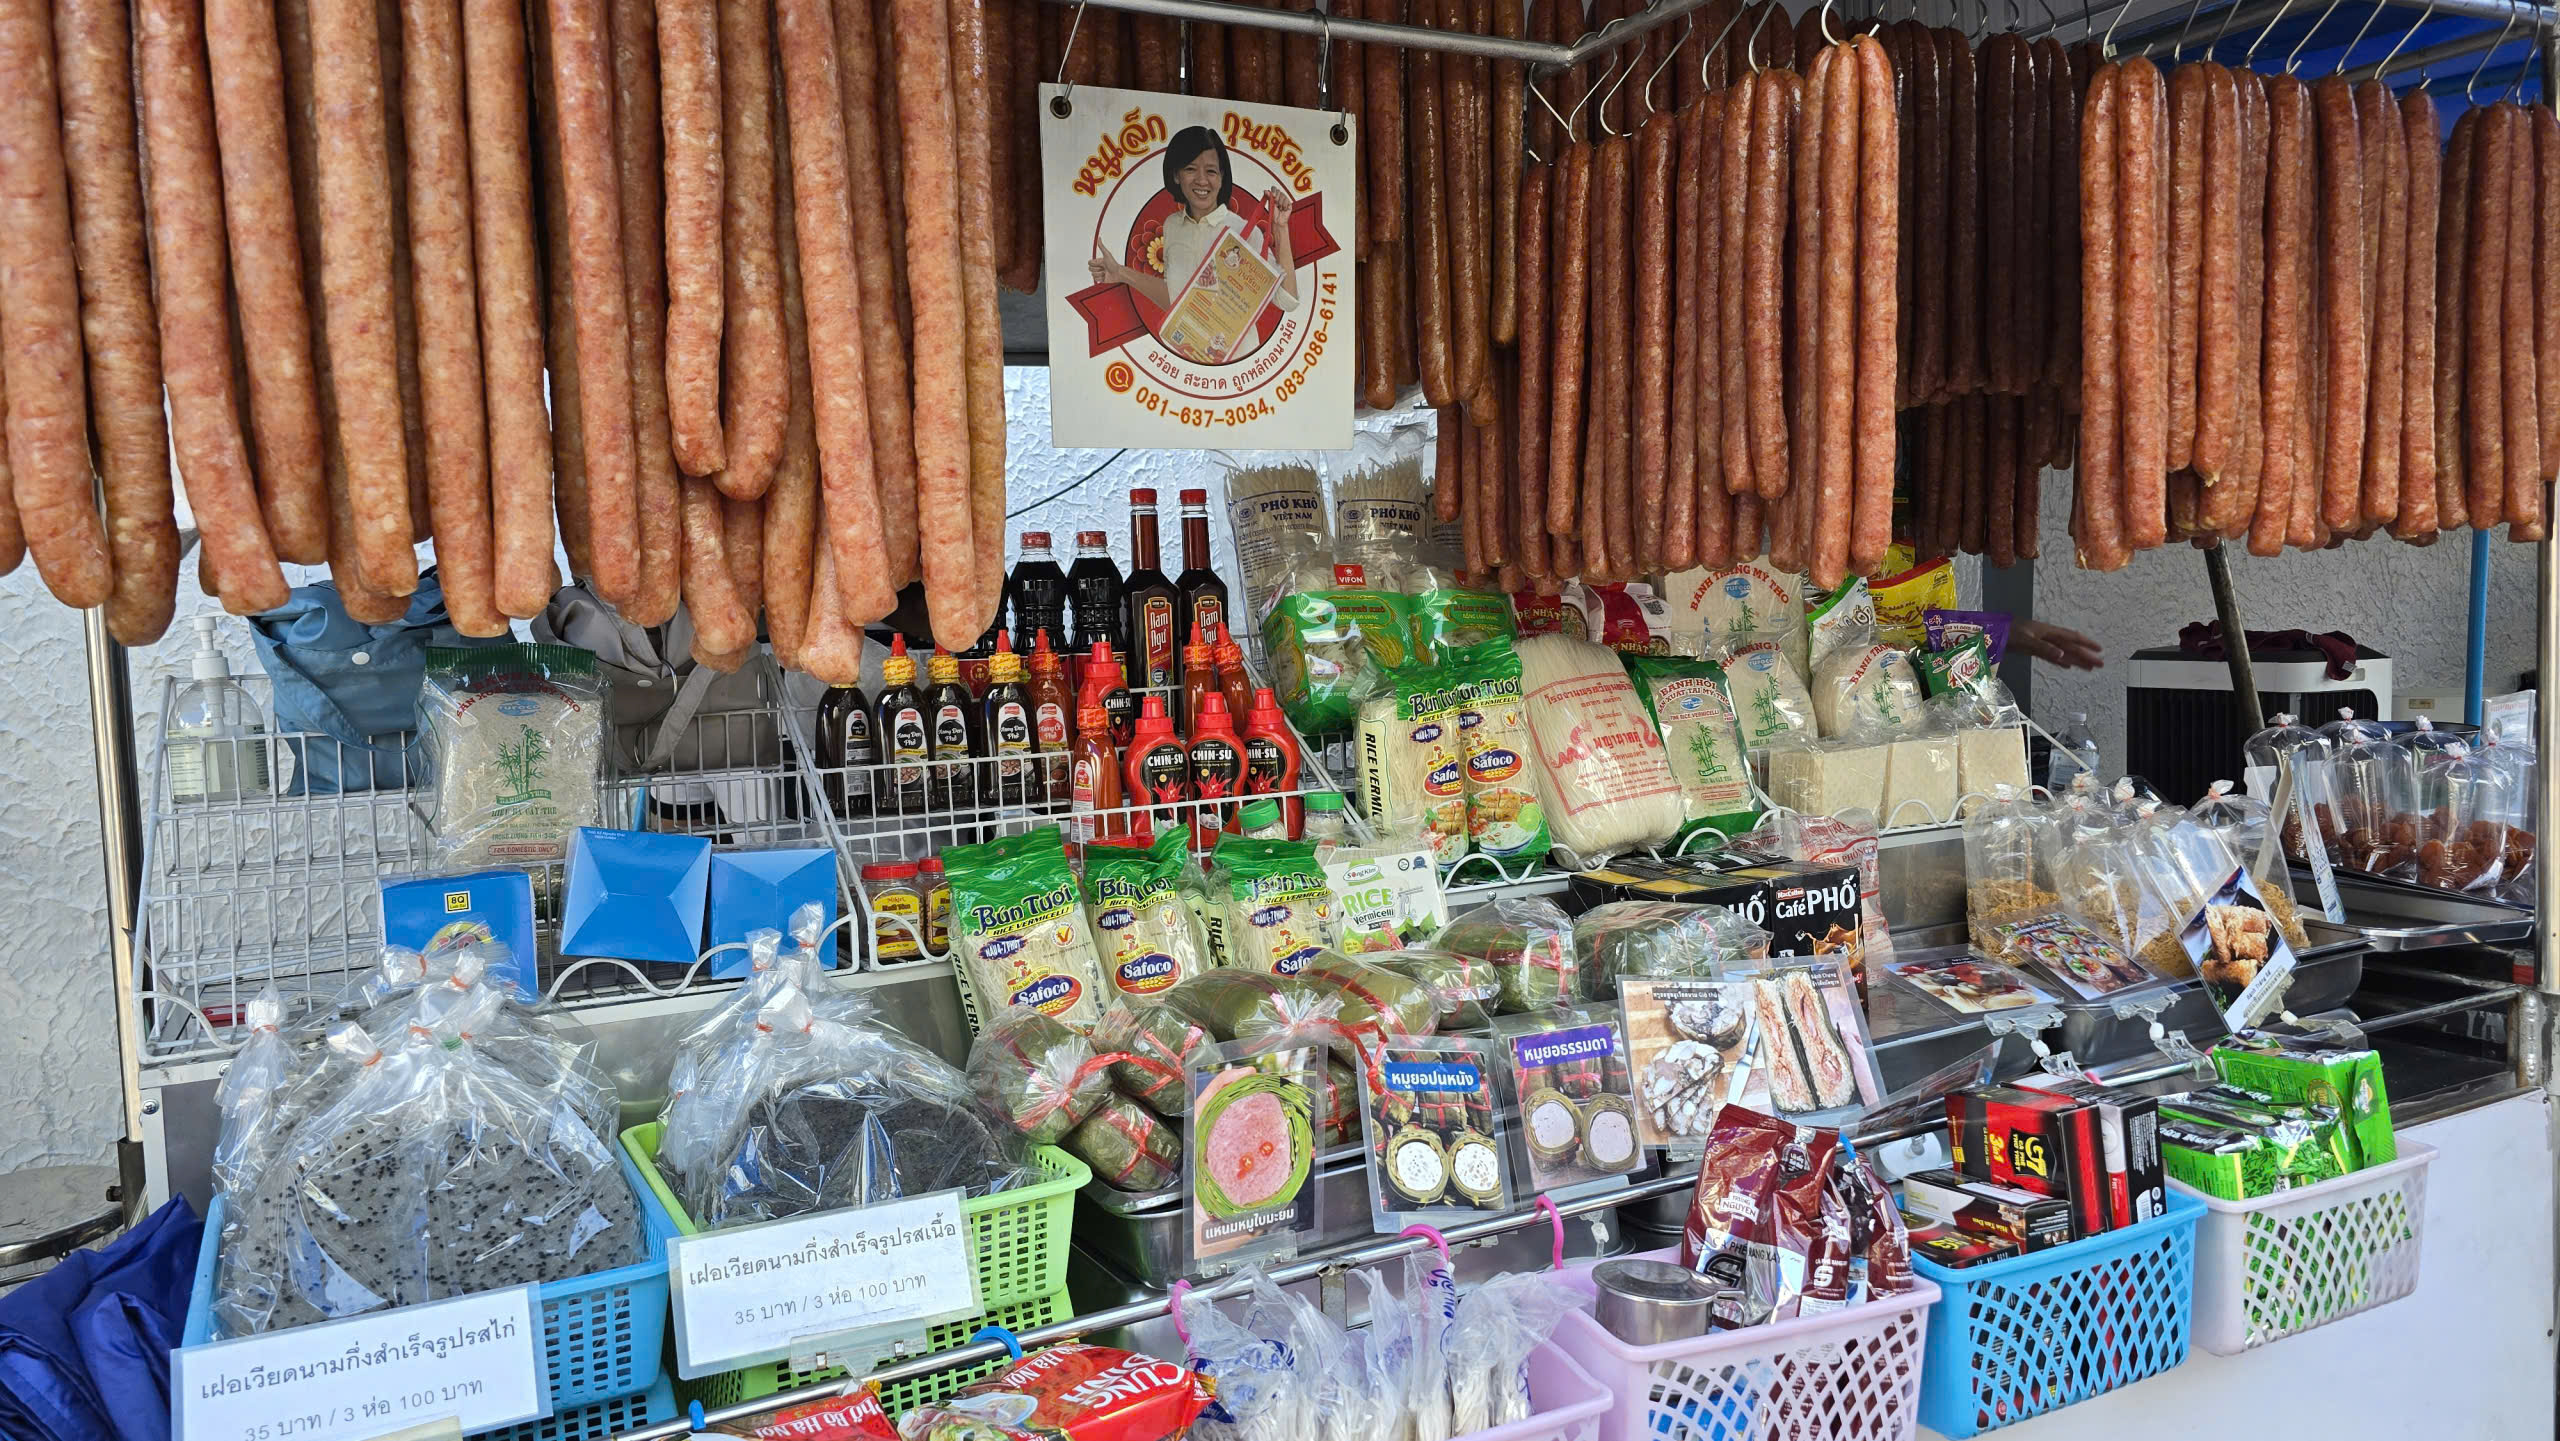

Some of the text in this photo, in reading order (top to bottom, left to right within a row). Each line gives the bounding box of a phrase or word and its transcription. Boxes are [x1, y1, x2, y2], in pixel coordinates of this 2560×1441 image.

[1222, 111, 1316, 194] กุนเชียง
[1136, 386, 1275, 427] 081-637-3034,
[1275, 273, 1337, 402] 083-086-6141
[1148, 319, 1297, 391] อร่อย สะอาด ถูกหลักอนามัย
[1292, 497, 1318, 509] KHÔ
[1295, 512, 1312, 520] NAM
[1398, 508, 1420, 521] KHÔ
[1339, 575, 1363, 583] VIFON
[1150, 611, 1168, 629] Nam
[1200, 611, 1218, 628] Nam
[1408, 692, 1440, 721] Bún
[1147, 753, 1184, 767] CHIN-SU
[1191, 749, 1233, 761] CHIN-SU
[1365, 733, 1377, 766] RICE
[1473, 754, 1514, 771] Safoco
[972, 884, 1074, 936] Bún Tươi
[1265, 895, 1284, 904] RICE
[1342, 888, 1393, 917] RICE
[1775, 876, 1857, 919] Café PHỐ
[992, 906, 1070, 935] RICE VERMICELLI
[1353, 909, 1394, 925] Vermicelli
[1209, 916, 1226, 960] RICE
[952, 952, 968, 987] RICE
[1124, 959, 1172, 979] Safoco
[1018, 980, 1070, 1007] Safoco
[1524, 1036, 1608, 1064] หมูยอธรรมดา
[1392, 1071, 1474, 1090] หมูยอปนหนัง
[1989, 1133, 2005, 1164] 3in1
[2025, 1136, 2048, 1178] G7
[1205, 1208, 1294, 1240] แหนมหมูใบมะยม
[689, 1212, 957, 1286] เฝอเวียดนามกึ่งสำเร็จรูปรสเนื้อ
[734, 1272, 928, 1325] 35 บาท / 3 ห่อ 100 บาท
[201, 1317, 516, 1400] เฝอเวียดนามกึ่งสำเร็จรูปรสไก่
[1092, 1361, 1186, 1409] CUNG
[244, 1377, 484, 1441] 35 บาท / 3 ห่อ 100 บาท
[824, 1405, 850, 1427] Bò
[792, 1416, 823, 1434] Hà
